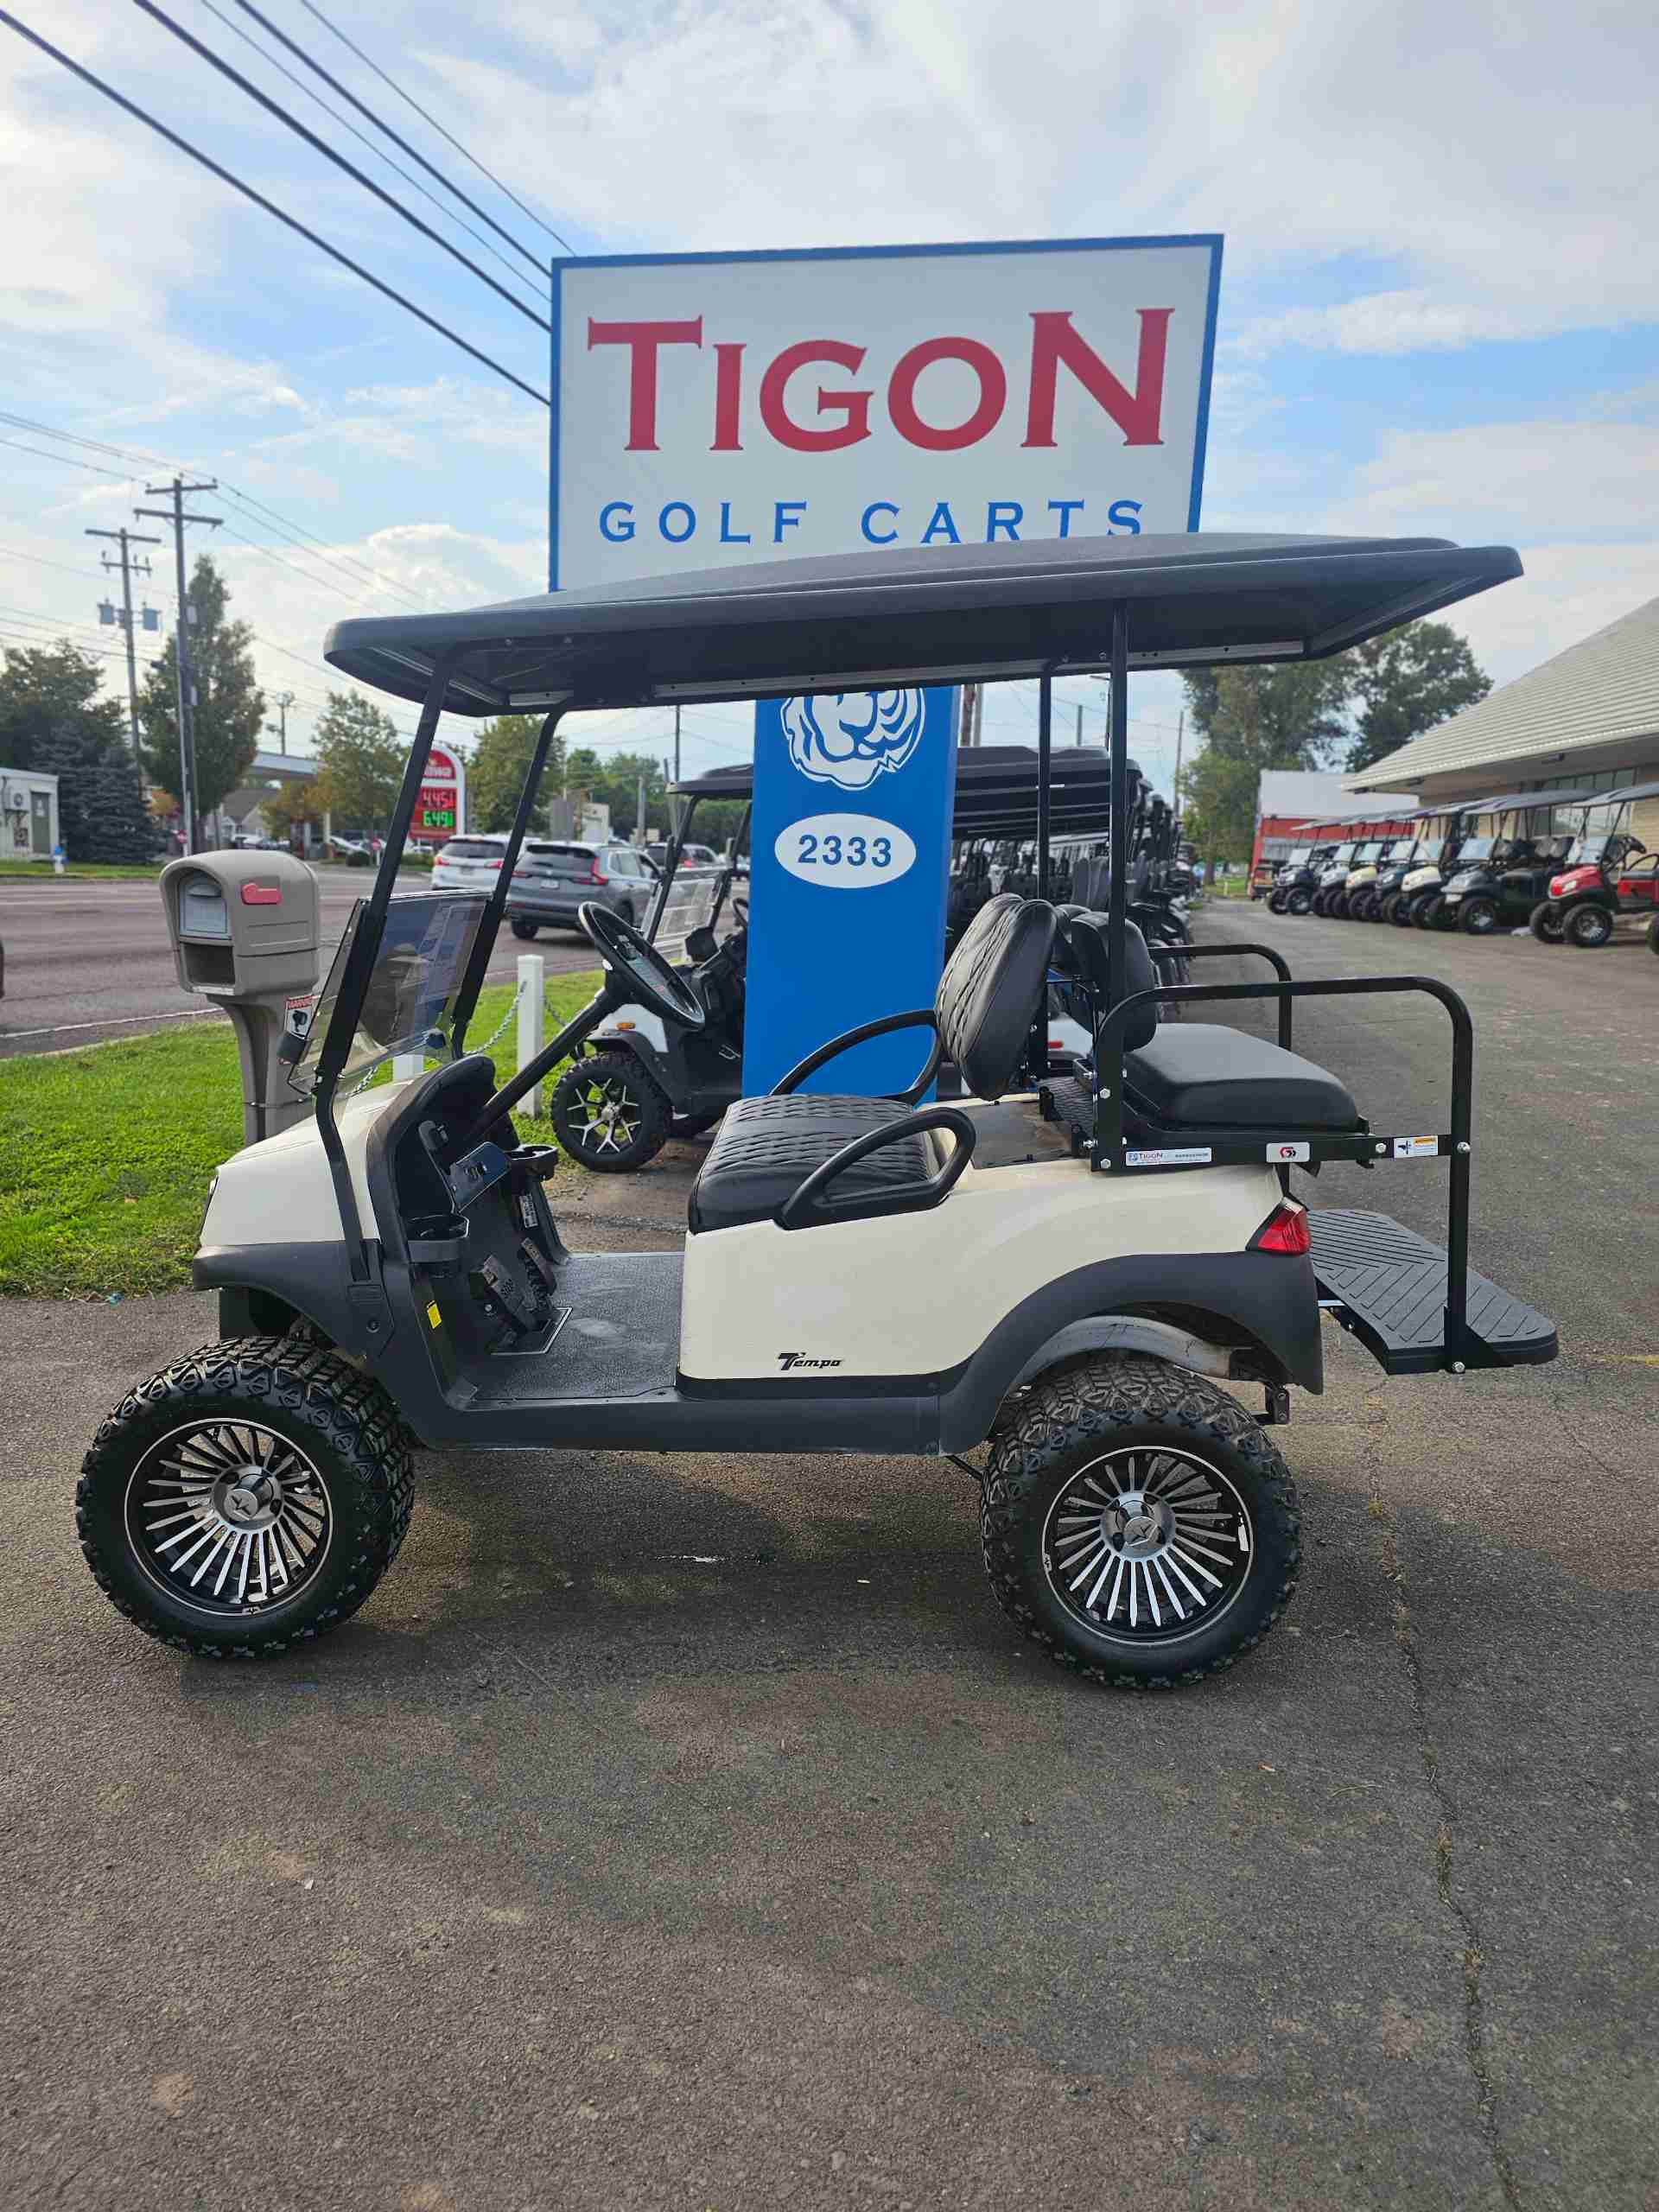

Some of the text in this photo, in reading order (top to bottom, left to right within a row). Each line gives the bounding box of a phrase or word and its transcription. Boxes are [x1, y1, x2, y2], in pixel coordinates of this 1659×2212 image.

[588, 308, 1175, 453] TIGON
[598, 499, 1144, 544] GOLF CARTS
[798, 834, 893, 868] 2333
[778, 1351, 842, 1371] Tempo
